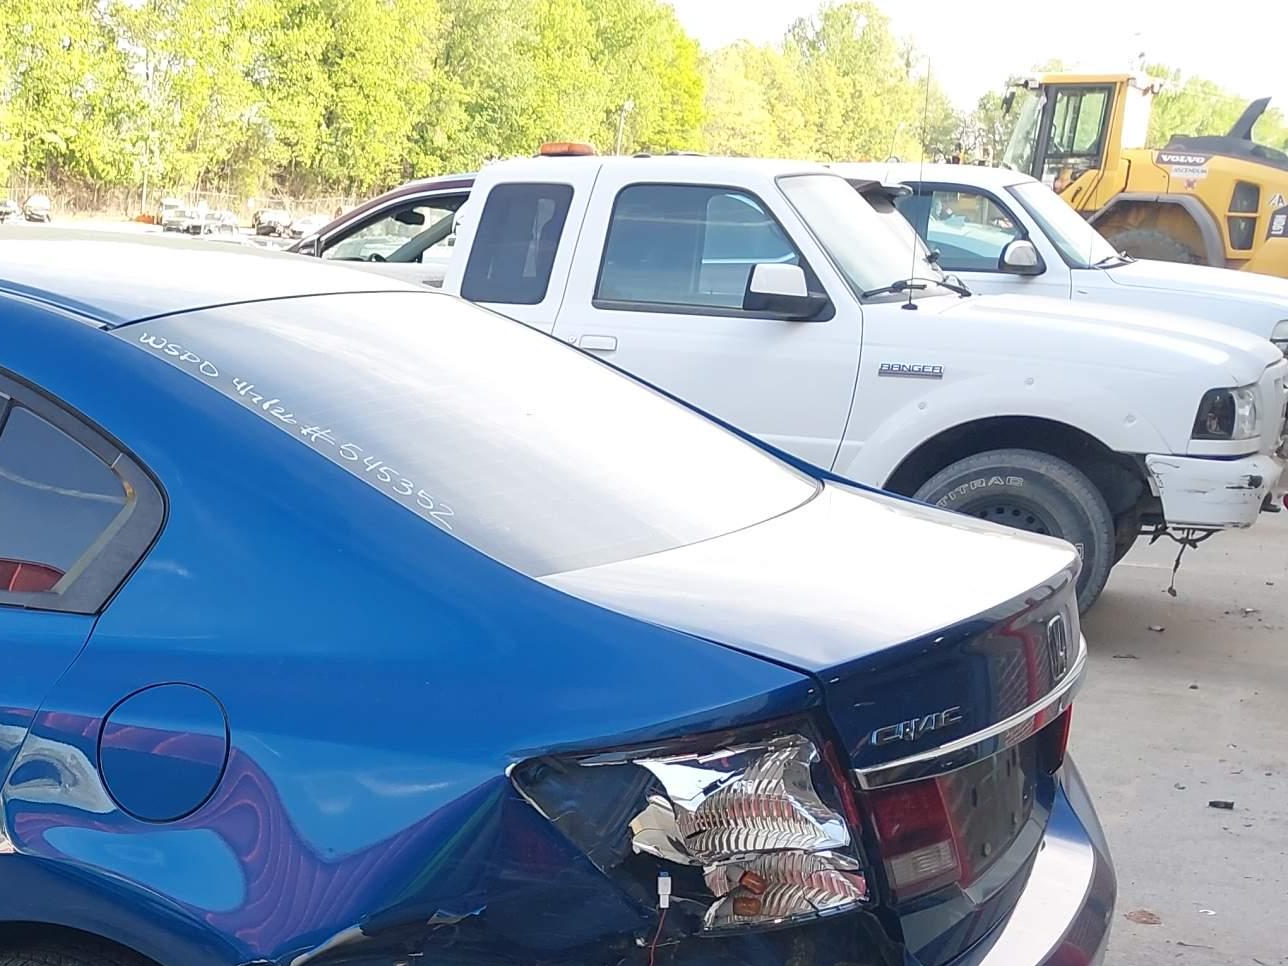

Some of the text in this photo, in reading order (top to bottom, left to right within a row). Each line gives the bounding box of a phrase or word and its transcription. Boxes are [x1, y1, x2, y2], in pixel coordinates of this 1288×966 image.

[1161, 154, 1205, 163] VOLVO
[879, 363, 943, 374] RANGER
[870, 705, 963, 745] CIVIC
